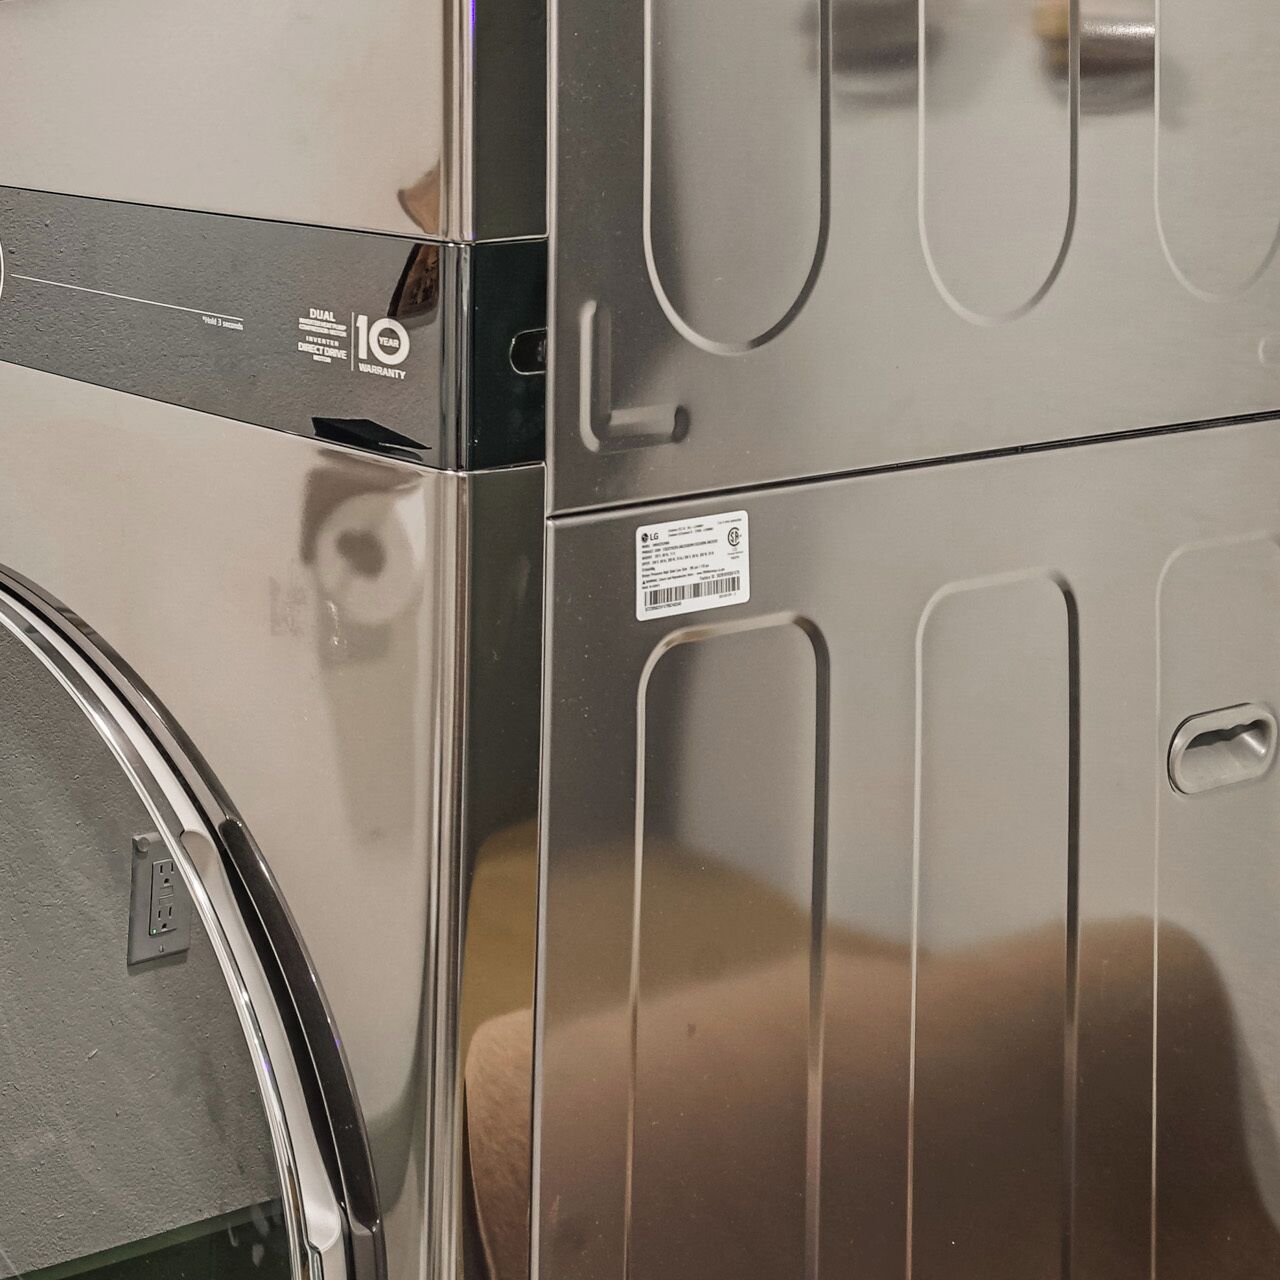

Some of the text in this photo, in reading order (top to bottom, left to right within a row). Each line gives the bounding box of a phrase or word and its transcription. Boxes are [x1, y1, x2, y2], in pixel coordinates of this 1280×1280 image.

[309, 308, 336, 322] DUAL
[305, 335, 339, 347] INVERTER
[356, 314, 410, 365] 10
[378, 336, 400, 348] YEAR
[298, 342, 324, 355] DIRECT
[324, 347, 347, 359] DRIVE
[358, 362, 406, 379] WARRANTY
[649, 532, 659, 541] LG
